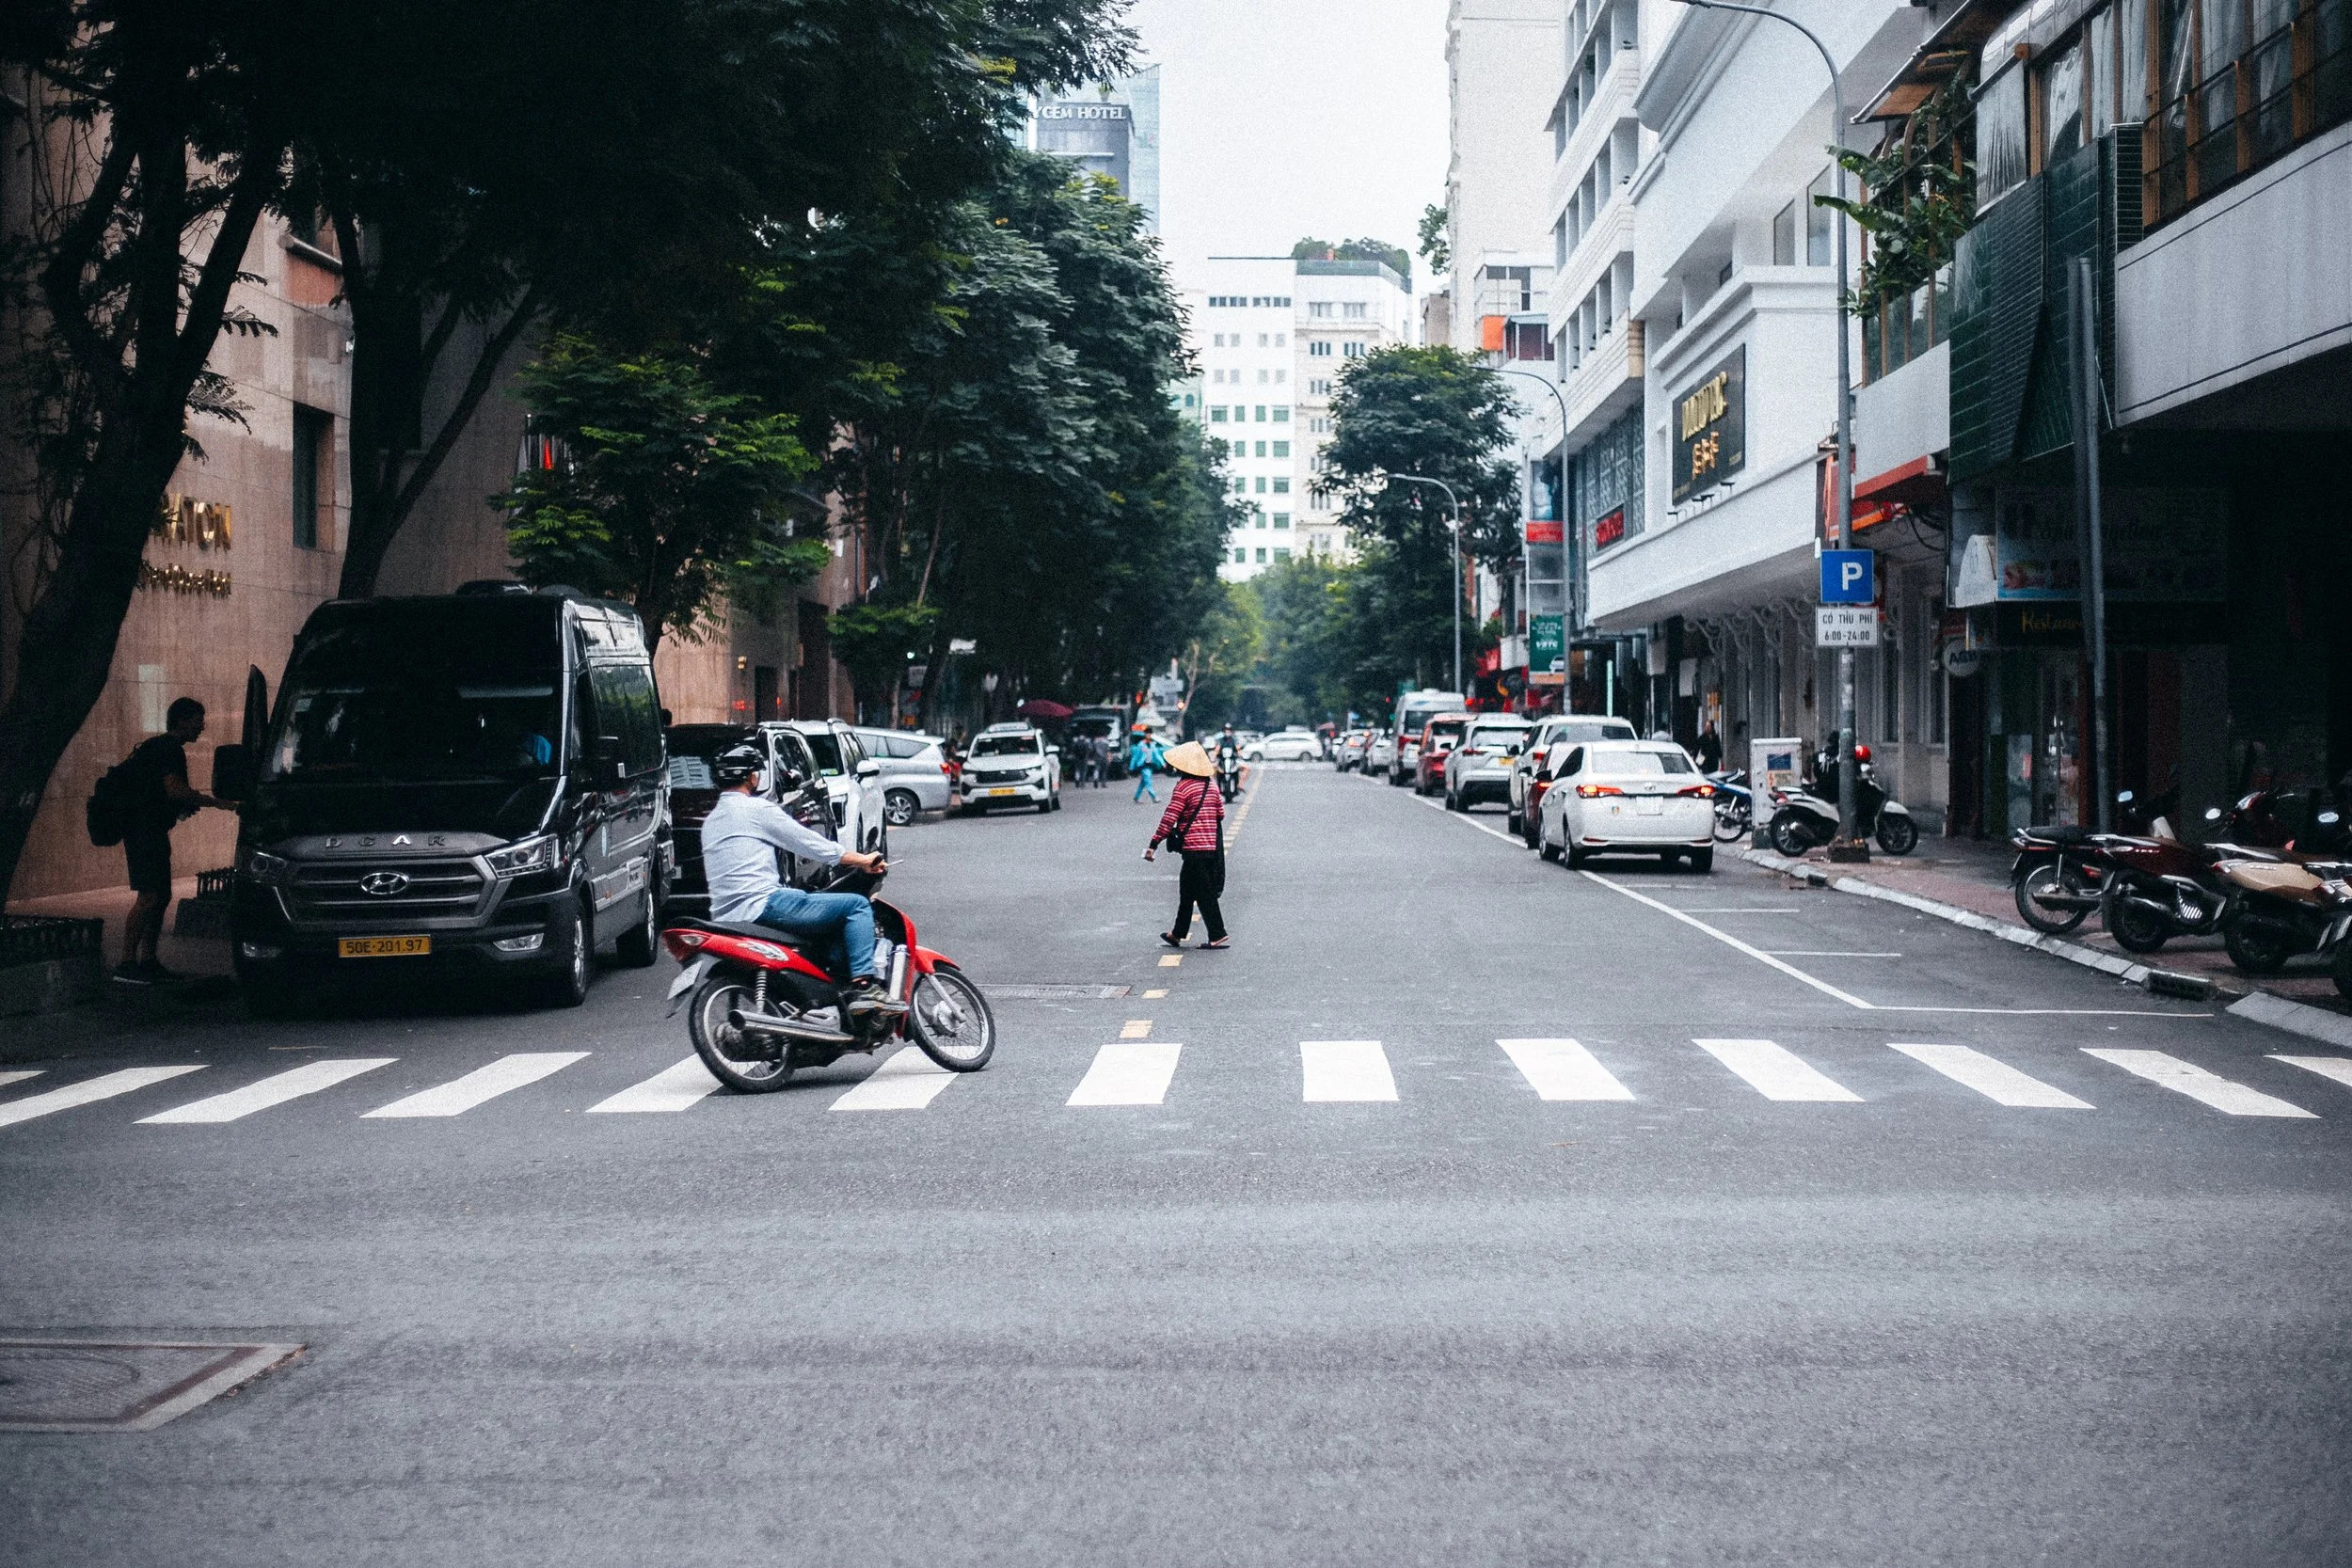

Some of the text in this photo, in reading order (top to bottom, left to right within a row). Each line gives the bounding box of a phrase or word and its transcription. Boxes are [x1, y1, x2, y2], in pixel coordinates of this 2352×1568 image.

[1077, 106, 1127, 119] HOTEL
[1842, 562, 1863, 591] P
[1822, 611, 1834, 625] CÓ
[1859, 610, 1873, 625] PHÍ
[326, 834, 445, 847] DCAR
[345, 940, 422, 954] 50E-201.97
